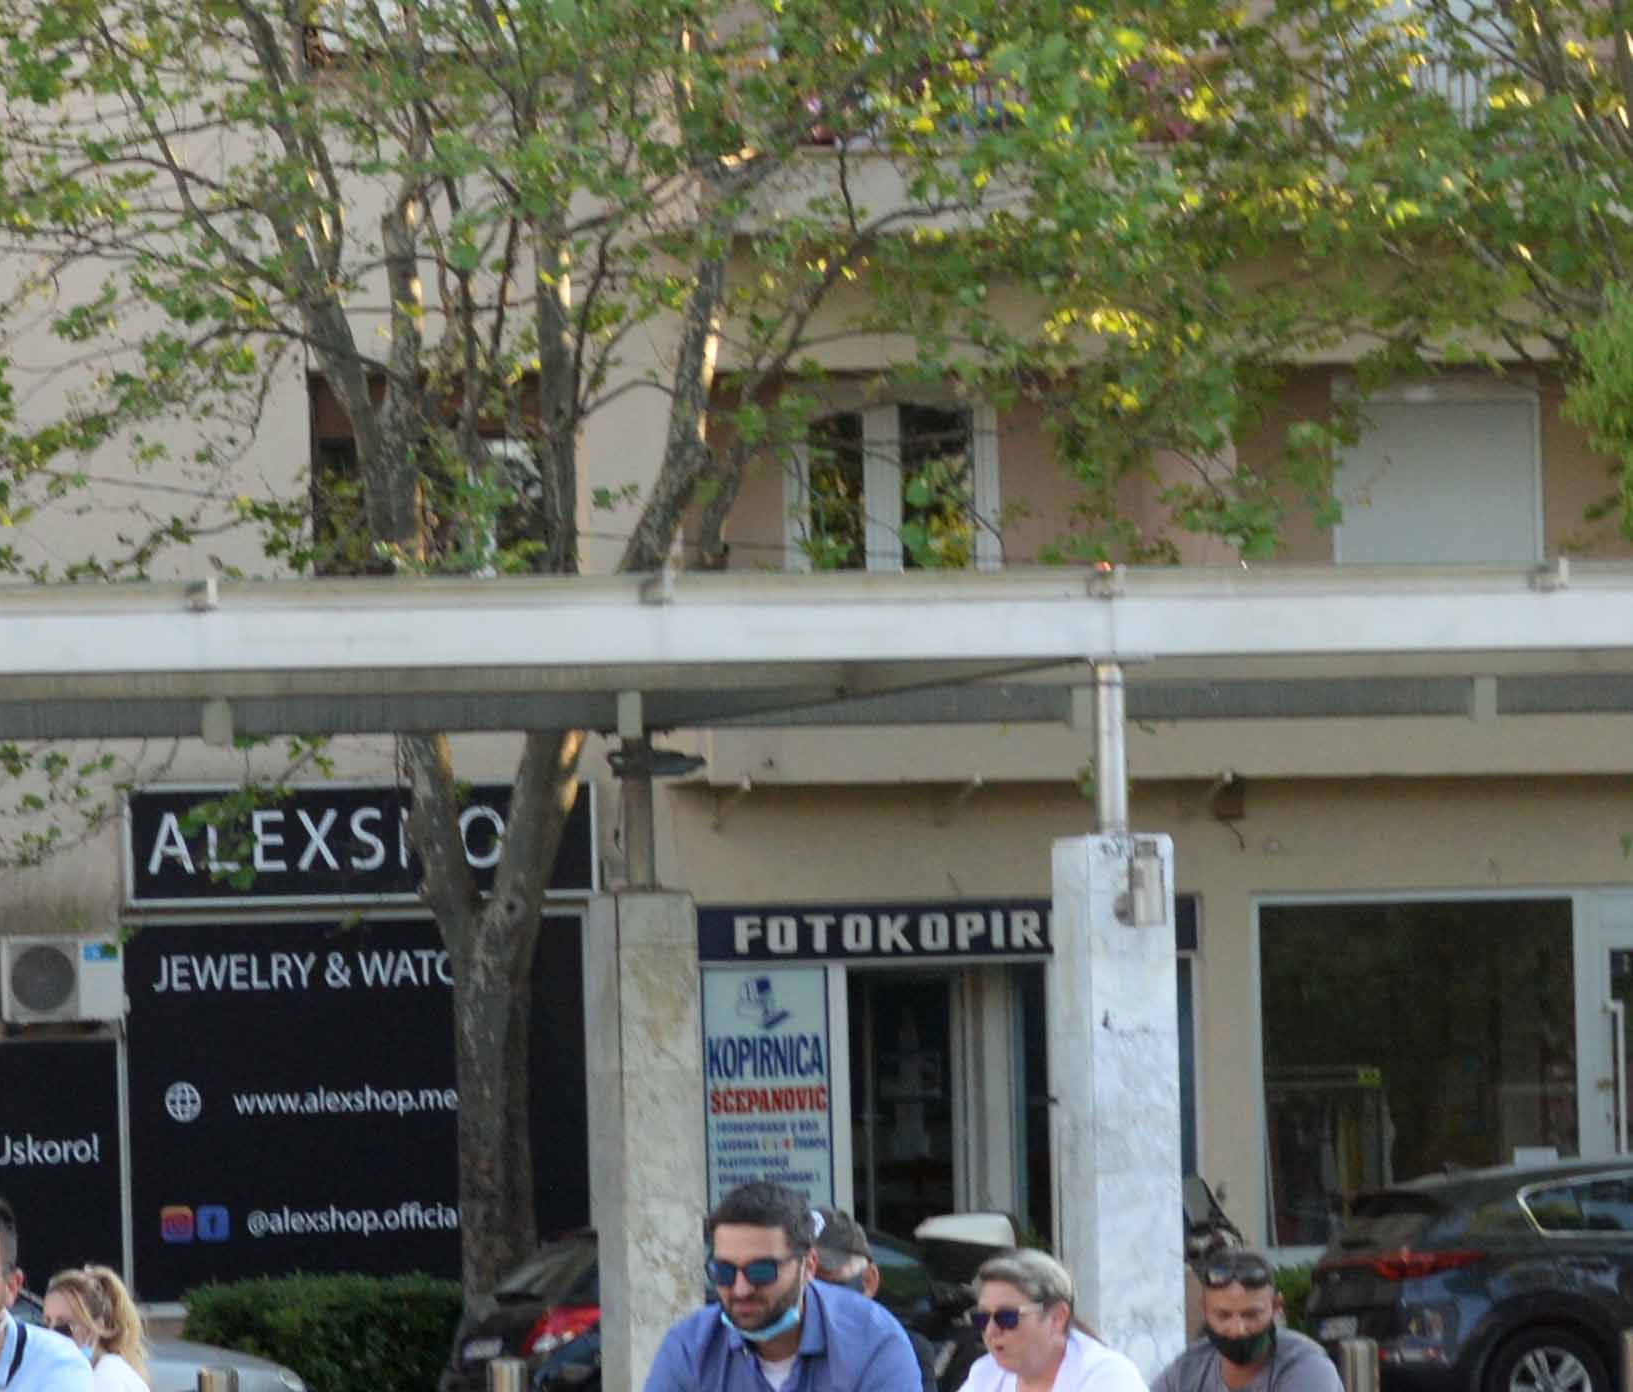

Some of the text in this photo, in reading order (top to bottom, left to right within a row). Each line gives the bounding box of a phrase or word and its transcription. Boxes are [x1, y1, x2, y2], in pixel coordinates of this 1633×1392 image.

[733, 910, 1053, 954] FOTOKOPIR
[153, 952, 317, 992] JEWELRY
[325, 951, 351, 988] &
[707, 1033, 824, 1078] KOPIRNICA
[234, 1085, 458, 1116] www.alexshop.me
